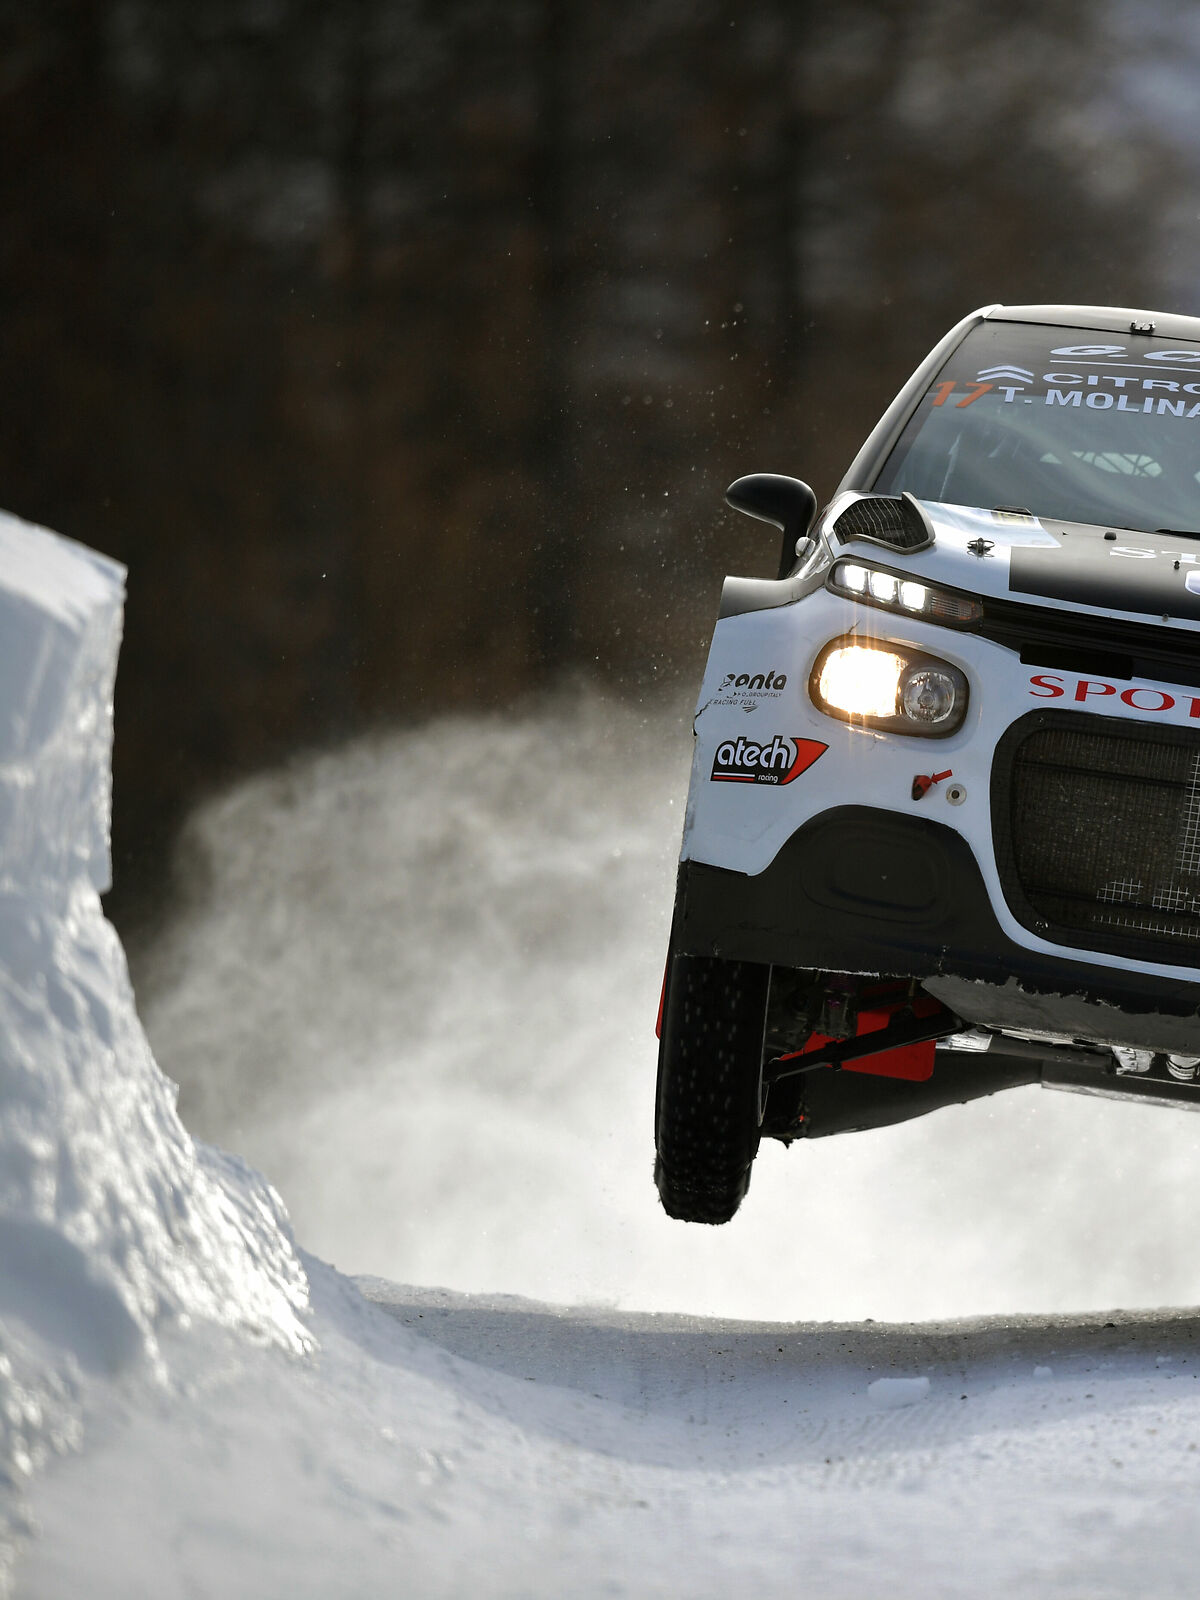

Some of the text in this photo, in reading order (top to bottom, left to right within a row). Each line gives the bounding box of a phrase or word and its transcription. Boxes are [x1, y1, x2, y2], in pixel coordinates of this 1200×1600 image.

[932, 381, 993, 408] 17
[999, 386, 1032, 404] T.
[717, 738, 790, 769] atech
[758, 773, 778, 783] racing
